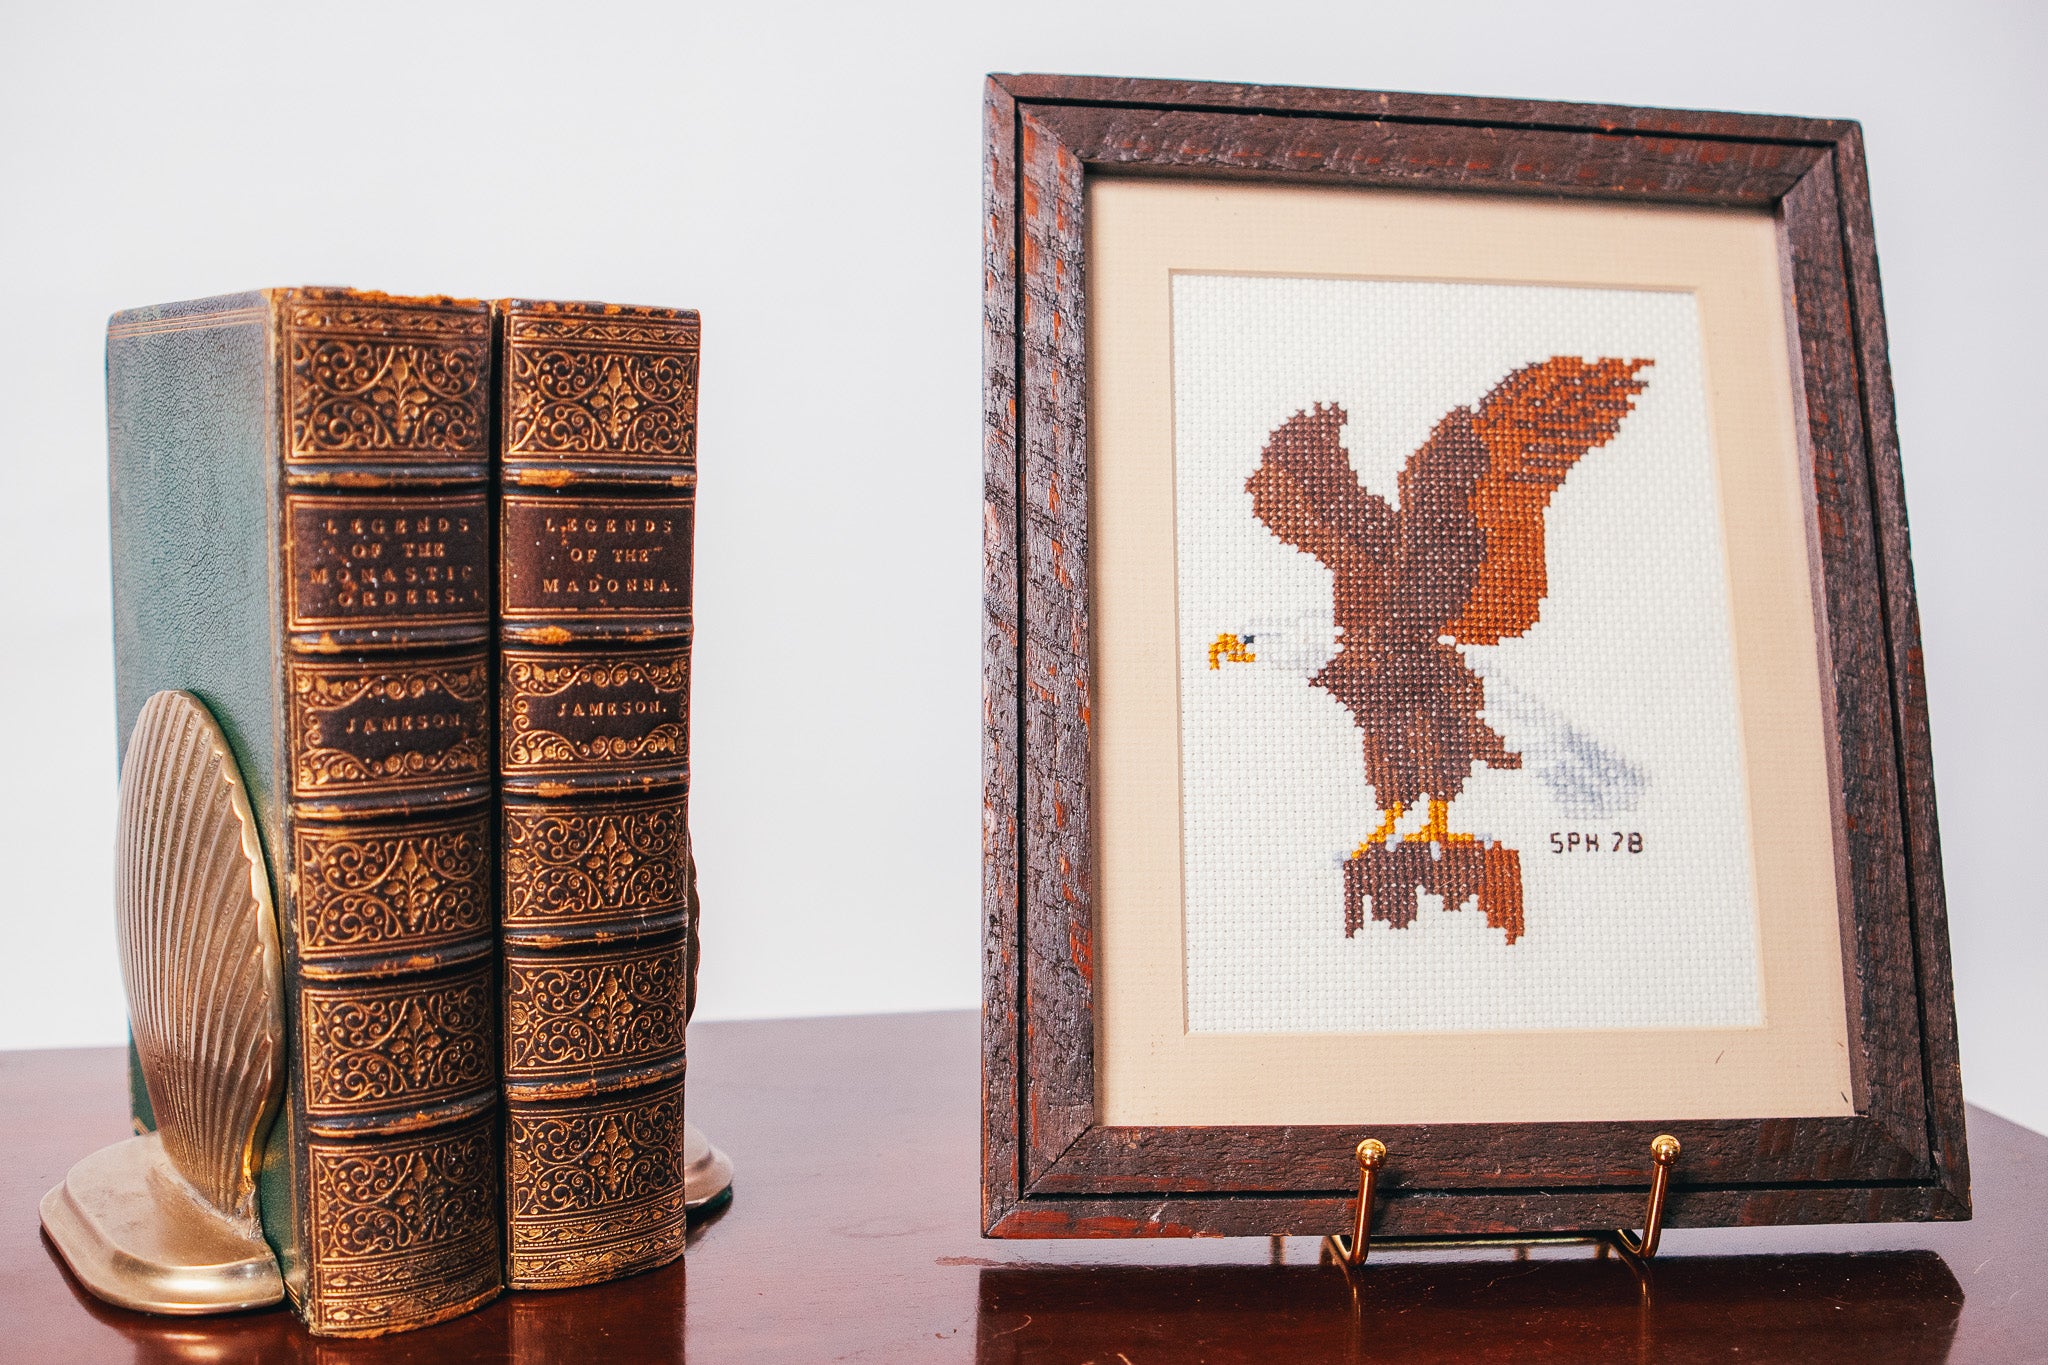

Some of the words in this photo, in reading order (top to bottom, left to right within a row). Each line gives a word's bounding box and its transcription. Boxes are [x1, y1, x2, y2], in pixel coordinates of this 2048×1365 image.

[326, 518, 469, 535] LEGENDS
[546, 518, 672, 533] LEGENDS
[352, 542, 382, 559] OF
[402, 542, 445, 558] THE
[570, 548, 597, 562] OF
[613, 548, 649, 562] THE
[310, 566, 472, 585] MONASTIC
[543, 578, 678, 593] MADONNA.
[557, 701, 667, 717] JAMESON.
